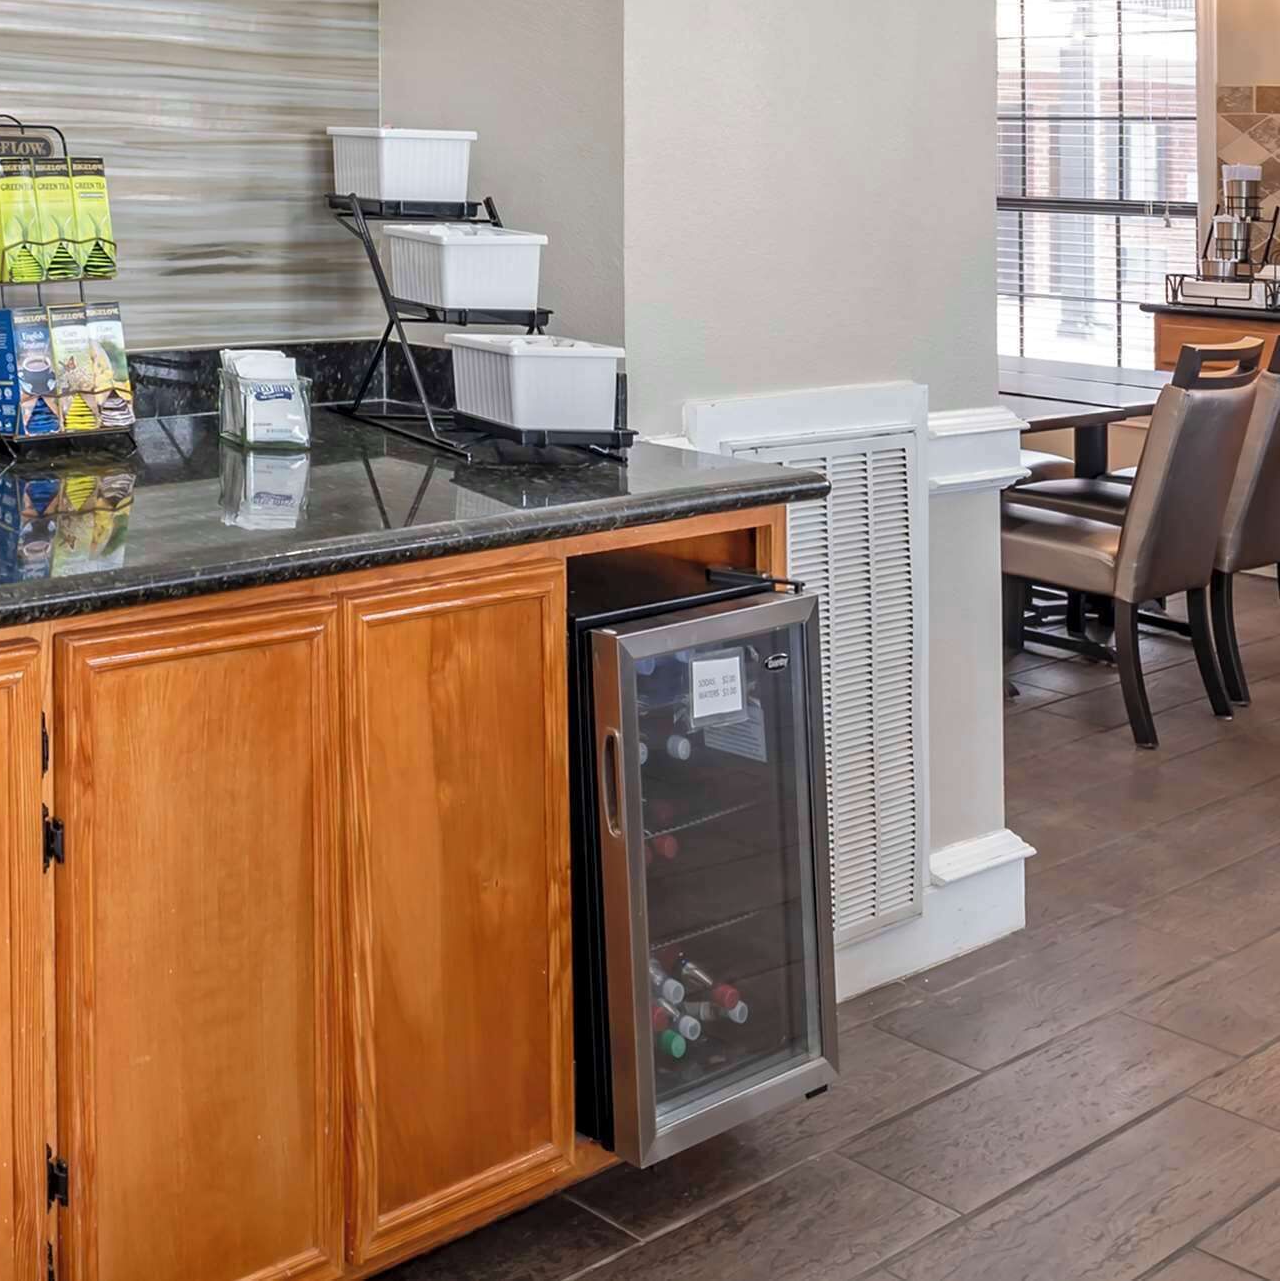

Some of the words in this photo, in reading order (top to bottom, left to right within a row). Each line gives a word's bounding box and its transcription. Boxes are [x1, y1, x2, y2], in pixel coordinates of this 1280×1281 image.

[0, 182, 22, 191] GREEN
[37, 182, 58, 191] GREEN
[58, 182, 70, 190] TEA
[74, 182, 95, 190] GREEN
[95, 182, 106, 190] TEA
